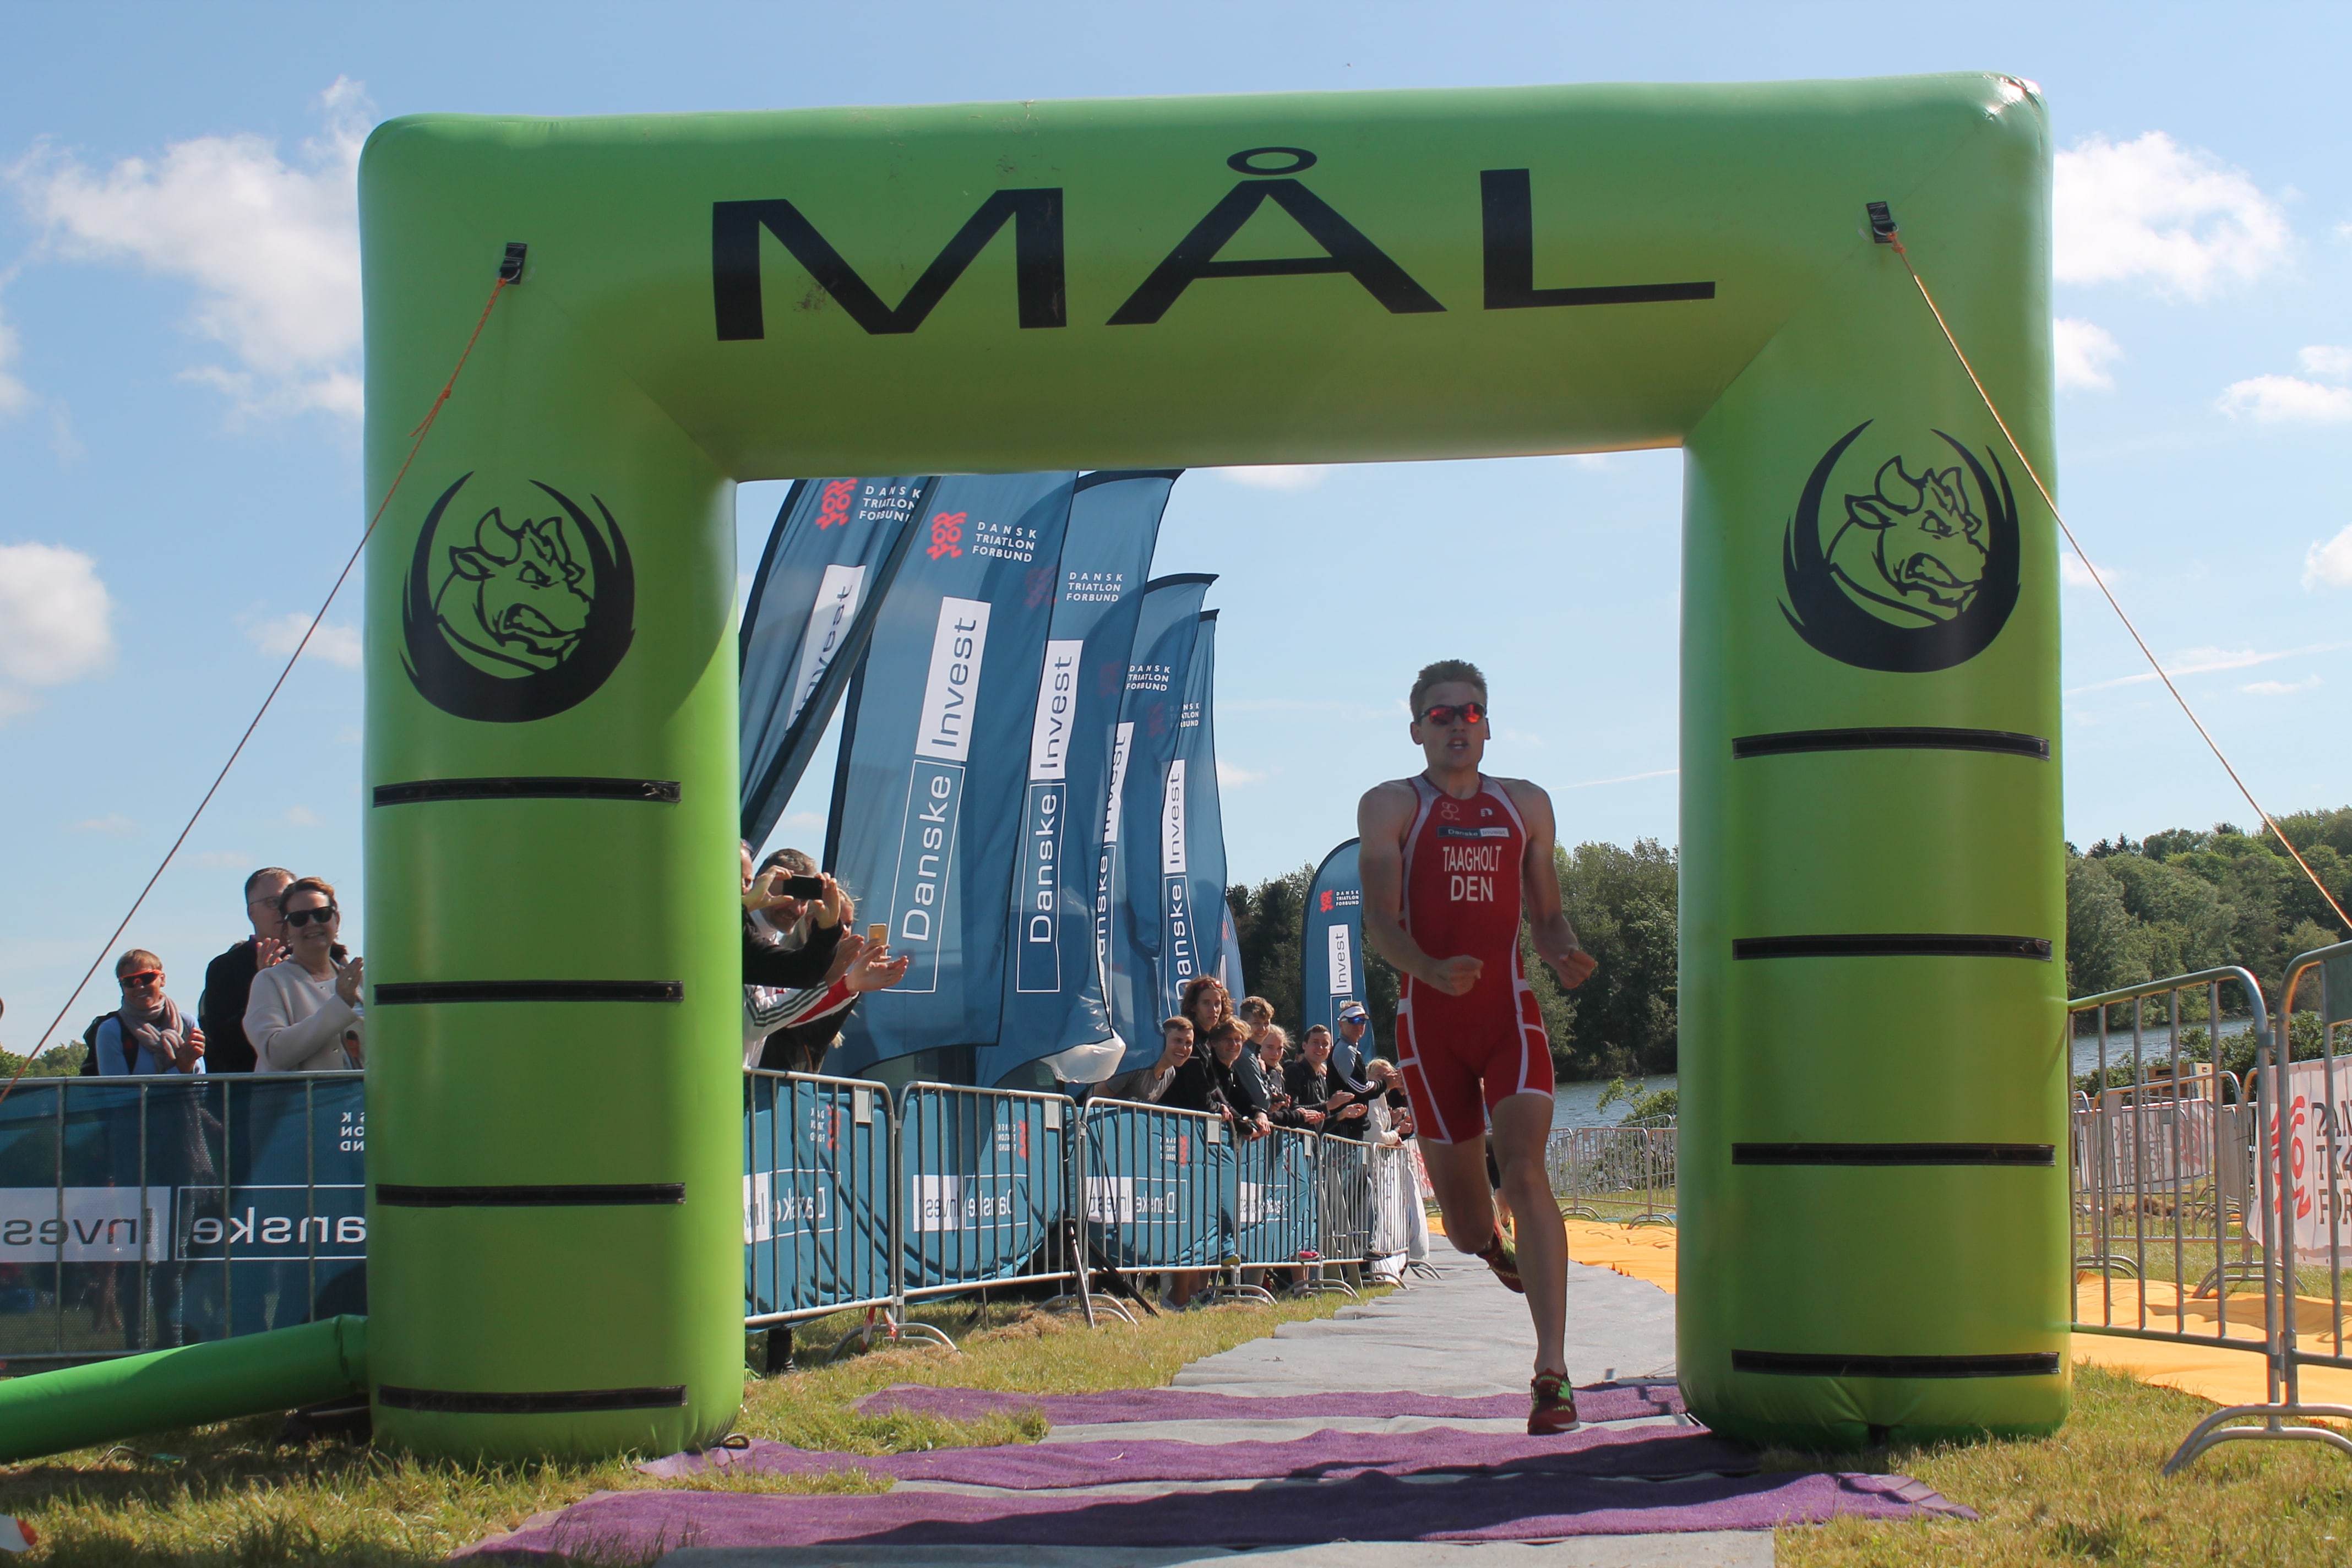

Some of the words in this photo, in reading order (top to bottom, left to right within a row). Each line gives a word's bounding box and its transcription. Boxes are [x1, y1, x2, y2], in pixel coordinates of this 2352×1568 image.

[712, 146, 1716, 341] MÅL
[865, 485, 922, 499] DANSK
[977, 521, 1037, 540] DANSK
[976, 533, 1035, 551] TRIATLON
[972, 545, 1033, 563] FORBUND
[1068, 582, 1121, 592] TRIATLON
[1069, 572, 1123, 582] DANSK
[1066, 592, 1119, 602] FORBUND
[796, 585, 853, 715] nvest
[1128, 673, 1169, 682] TRIATLON
[1129, 665, 1170, 673] DANSK
[1125, 682, 1168, 692] FORBUND
[1039, 655, 1072, 769] Invest
[901, 775, 951, 941] Danske
[931, 617, 977, 748] Invest
[1169, 772, 1180, 864] Invest
[1029, 793, 1058, 943] Danske
[1443, 846, 1501, 872] TAAGHOLT
[1451, 875, 1493, 901] DEN
[1096, 855, 1108, 983] anske
[1335, 932, 1347, 988] Invest
